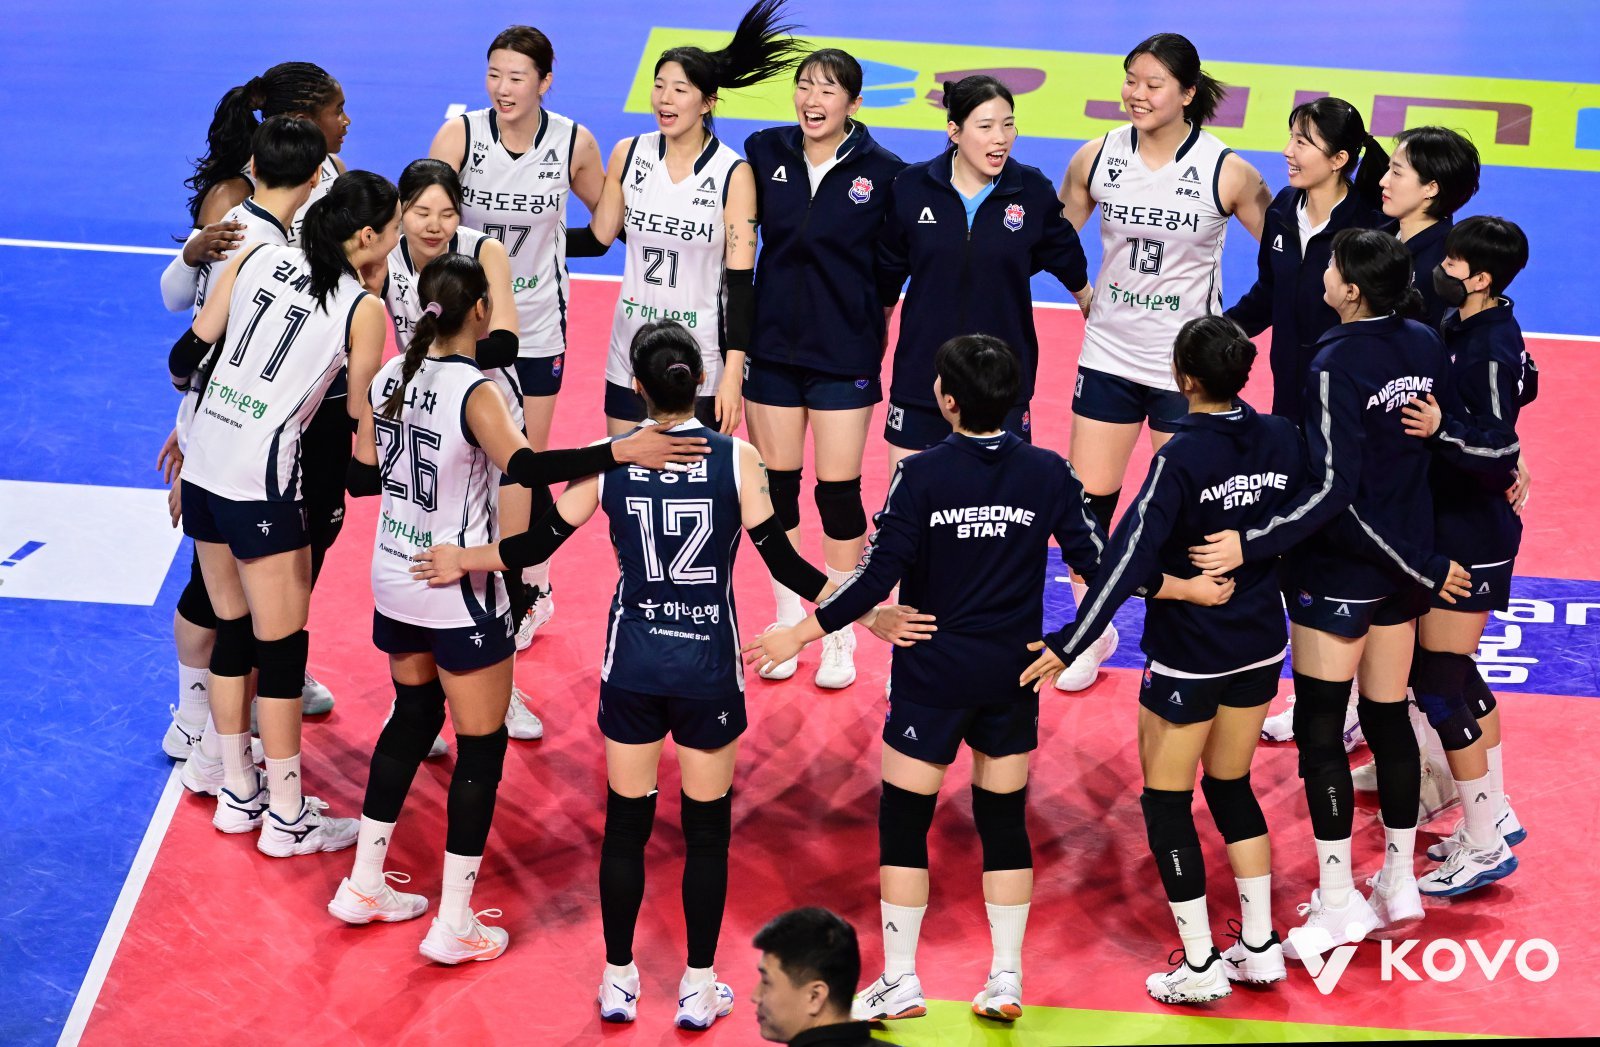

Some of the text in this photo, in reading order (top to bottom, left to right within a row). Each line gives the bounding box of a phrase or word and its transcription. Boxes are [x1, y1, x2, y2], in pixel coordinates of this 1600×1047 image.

[1107, 156, 1128, 168] 김천시
[460, 186, 561, 215] 한국도로공사
[1102, 201, 1200, 232] 한국도로공사
[642, 246, 679, 288] 21
[1126, 236, 1165, 276] 13
[272, 260, 314, 294] 김세
[1122, 290, 1180, 311] 하나은행
[229, 287, 311, 382] 11
[219, 385, 269, 419] 하나은행
[1366, 376, 1434, 410] AWESOME
[1385, 391, 1418, 413] STAR
[373, 411, 441, 512] 26
[1199, 472, 1288, 504] AWESOME
[1223, 489, 1262, 510] STAR
[930, 505, 1036, 527] AWESOME
[389, 519, 433, 548] 하나은행
[625, 496, 717, 585] 12
[957, 523, 1007, 539] STAR
[663, 601, 719, 625] 하나은행
[657, 628, 695, 640] AWESOME
[694, 634, 711, 642] STAR
